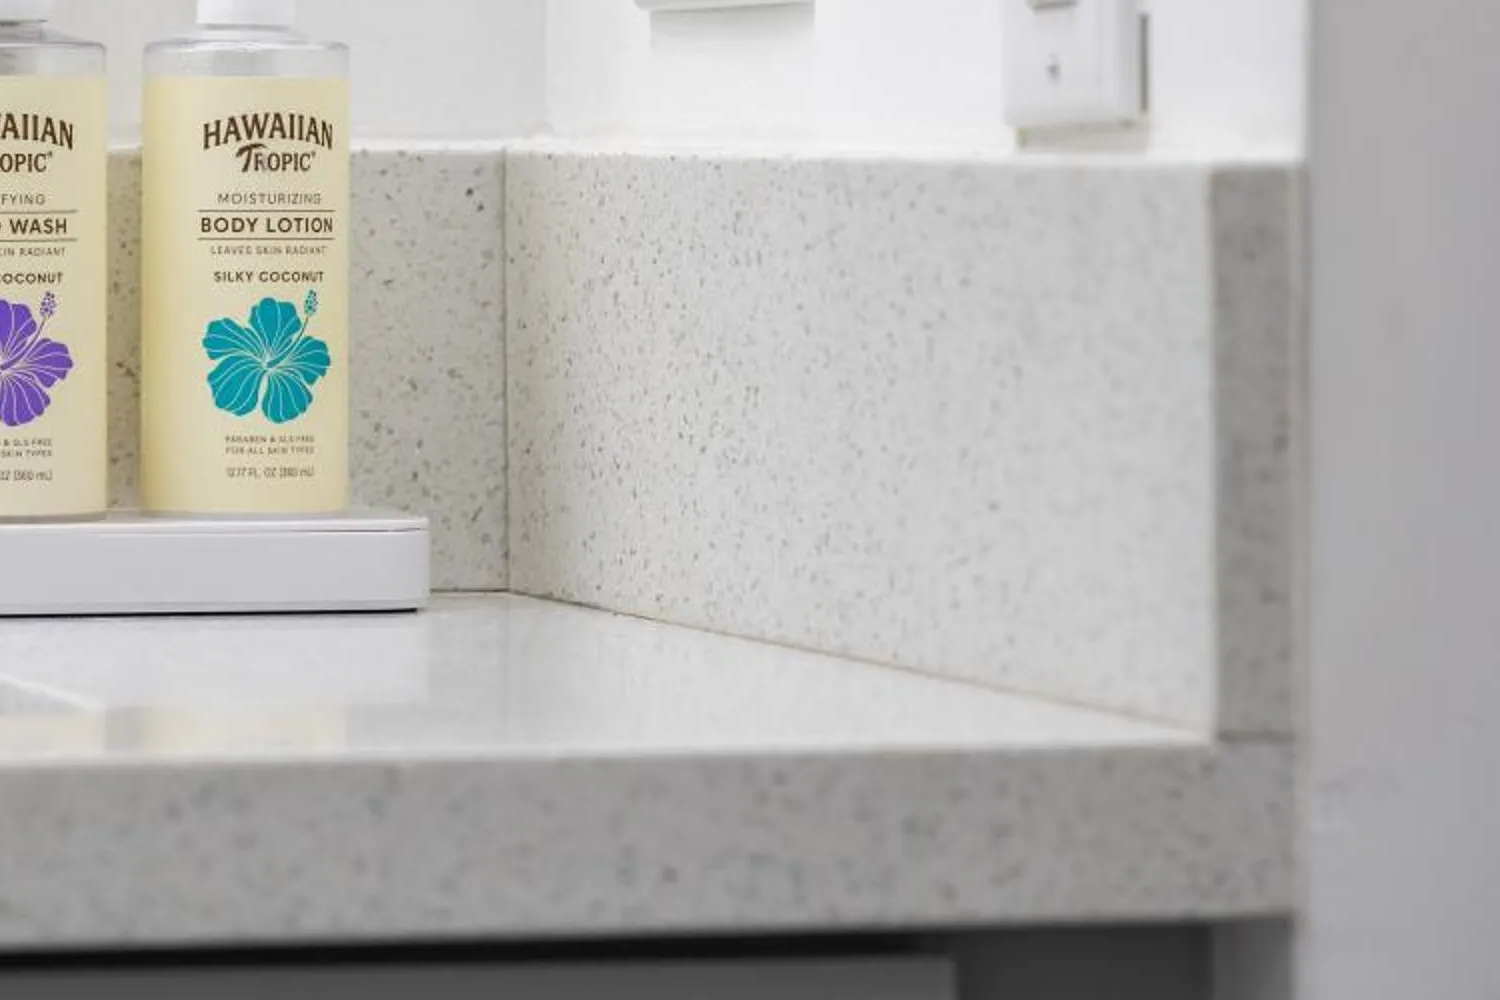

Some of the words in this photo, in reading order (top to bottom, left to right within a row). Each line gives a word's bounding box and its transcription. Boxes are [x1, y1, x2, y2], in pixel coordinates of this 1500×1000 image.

[203, 112, 333, 150] HAWAIIAN
[217, 193, 322, 205] MOISTURIZING
[9, 218, 68, 235] WASH
[201, 217, 258, 233] BODY
[266, 217, 333, 233] LOTION
[19, 247, 66, 257] RADIANT
[210, 245, 251, 255] LEAVES
[255, 245, 282, 255] SKIN
[285, 245, 327, 255] RADIANT
[213, 271, 253, 283] SILKY
[258, 271, 324, 283] COCONUT
